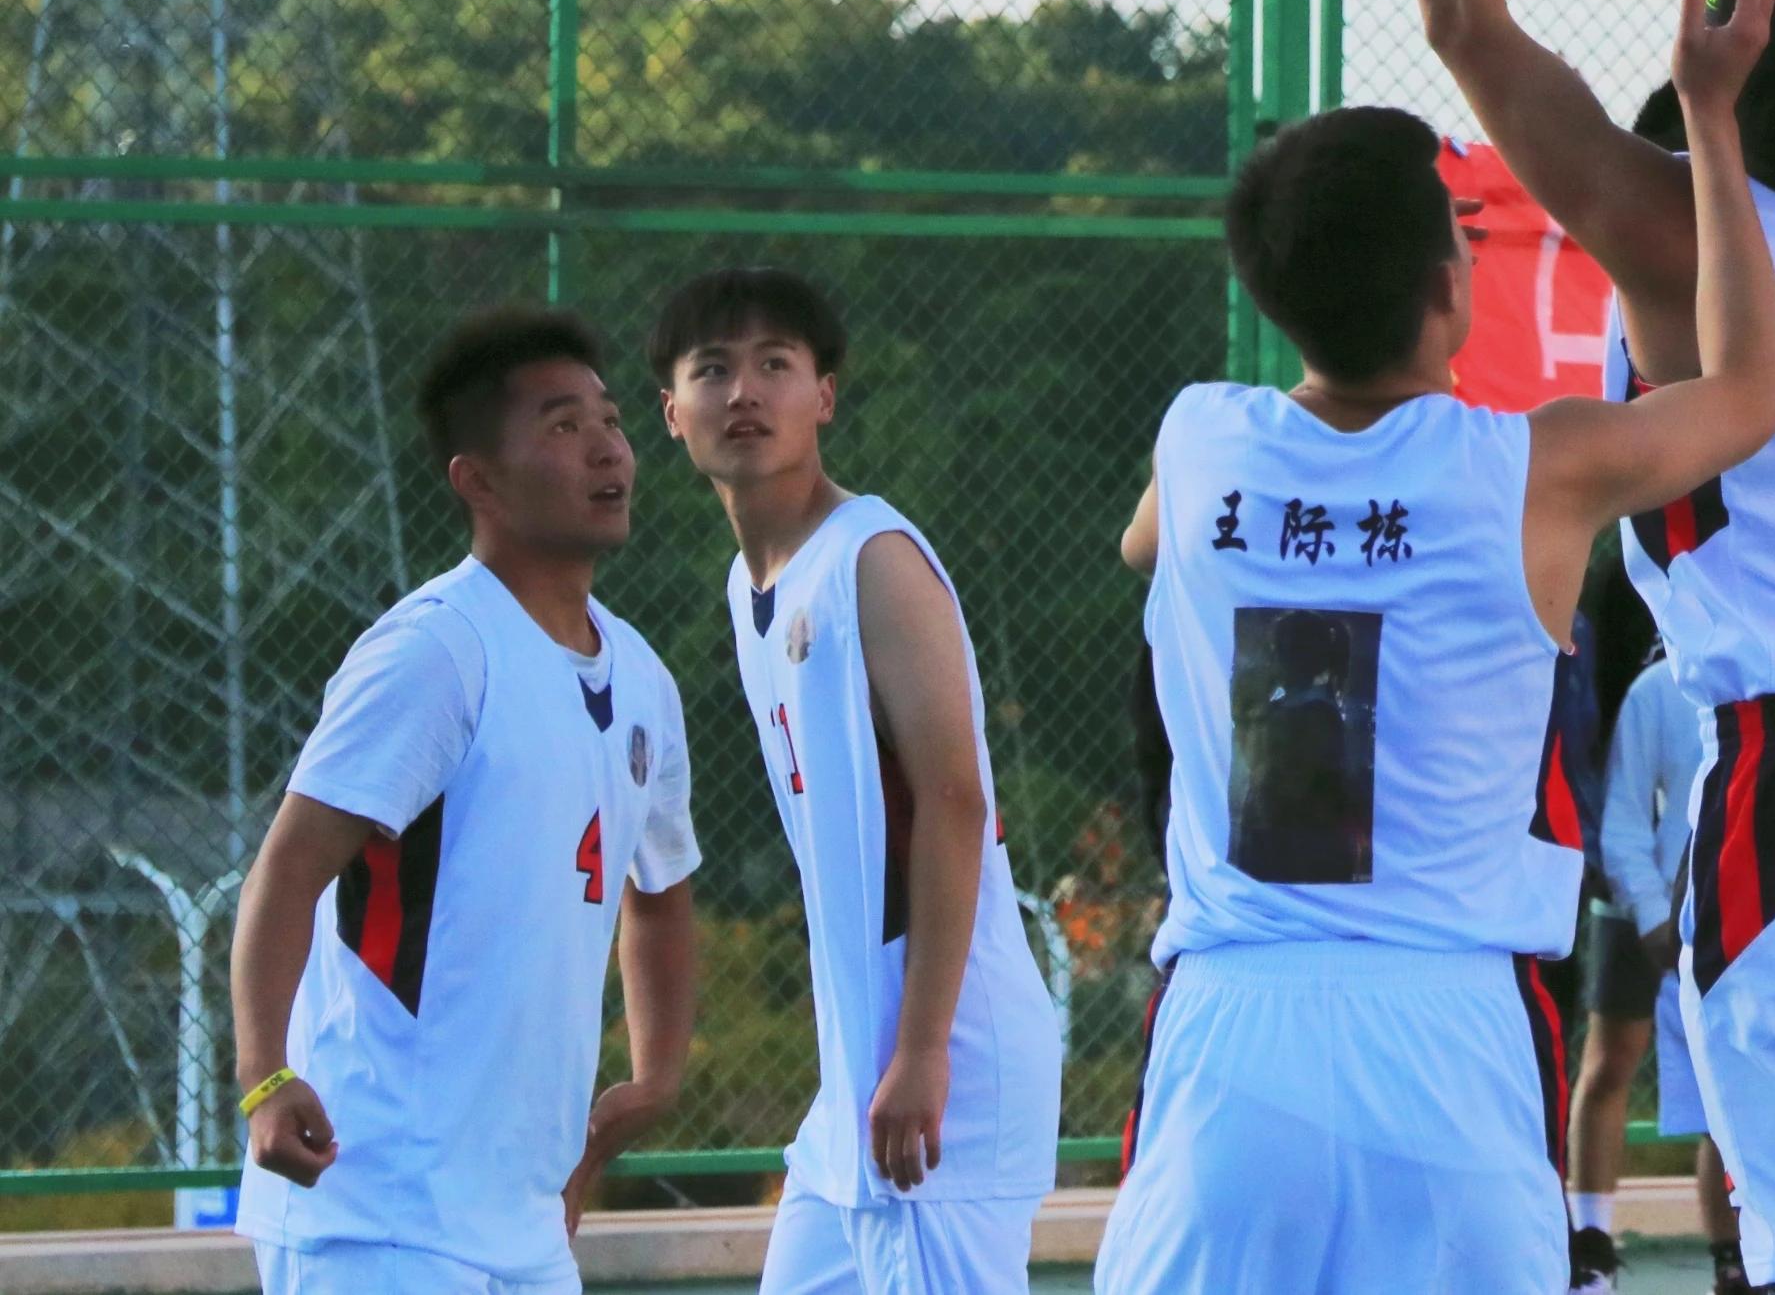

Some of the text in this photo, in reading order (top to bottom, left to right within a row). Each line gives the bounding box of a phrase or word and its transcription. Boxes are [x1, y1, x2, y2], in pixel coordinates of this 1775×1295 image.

[1211, 489, 1414, 567] 王际栋
[576, 805, 604, 905] 4
